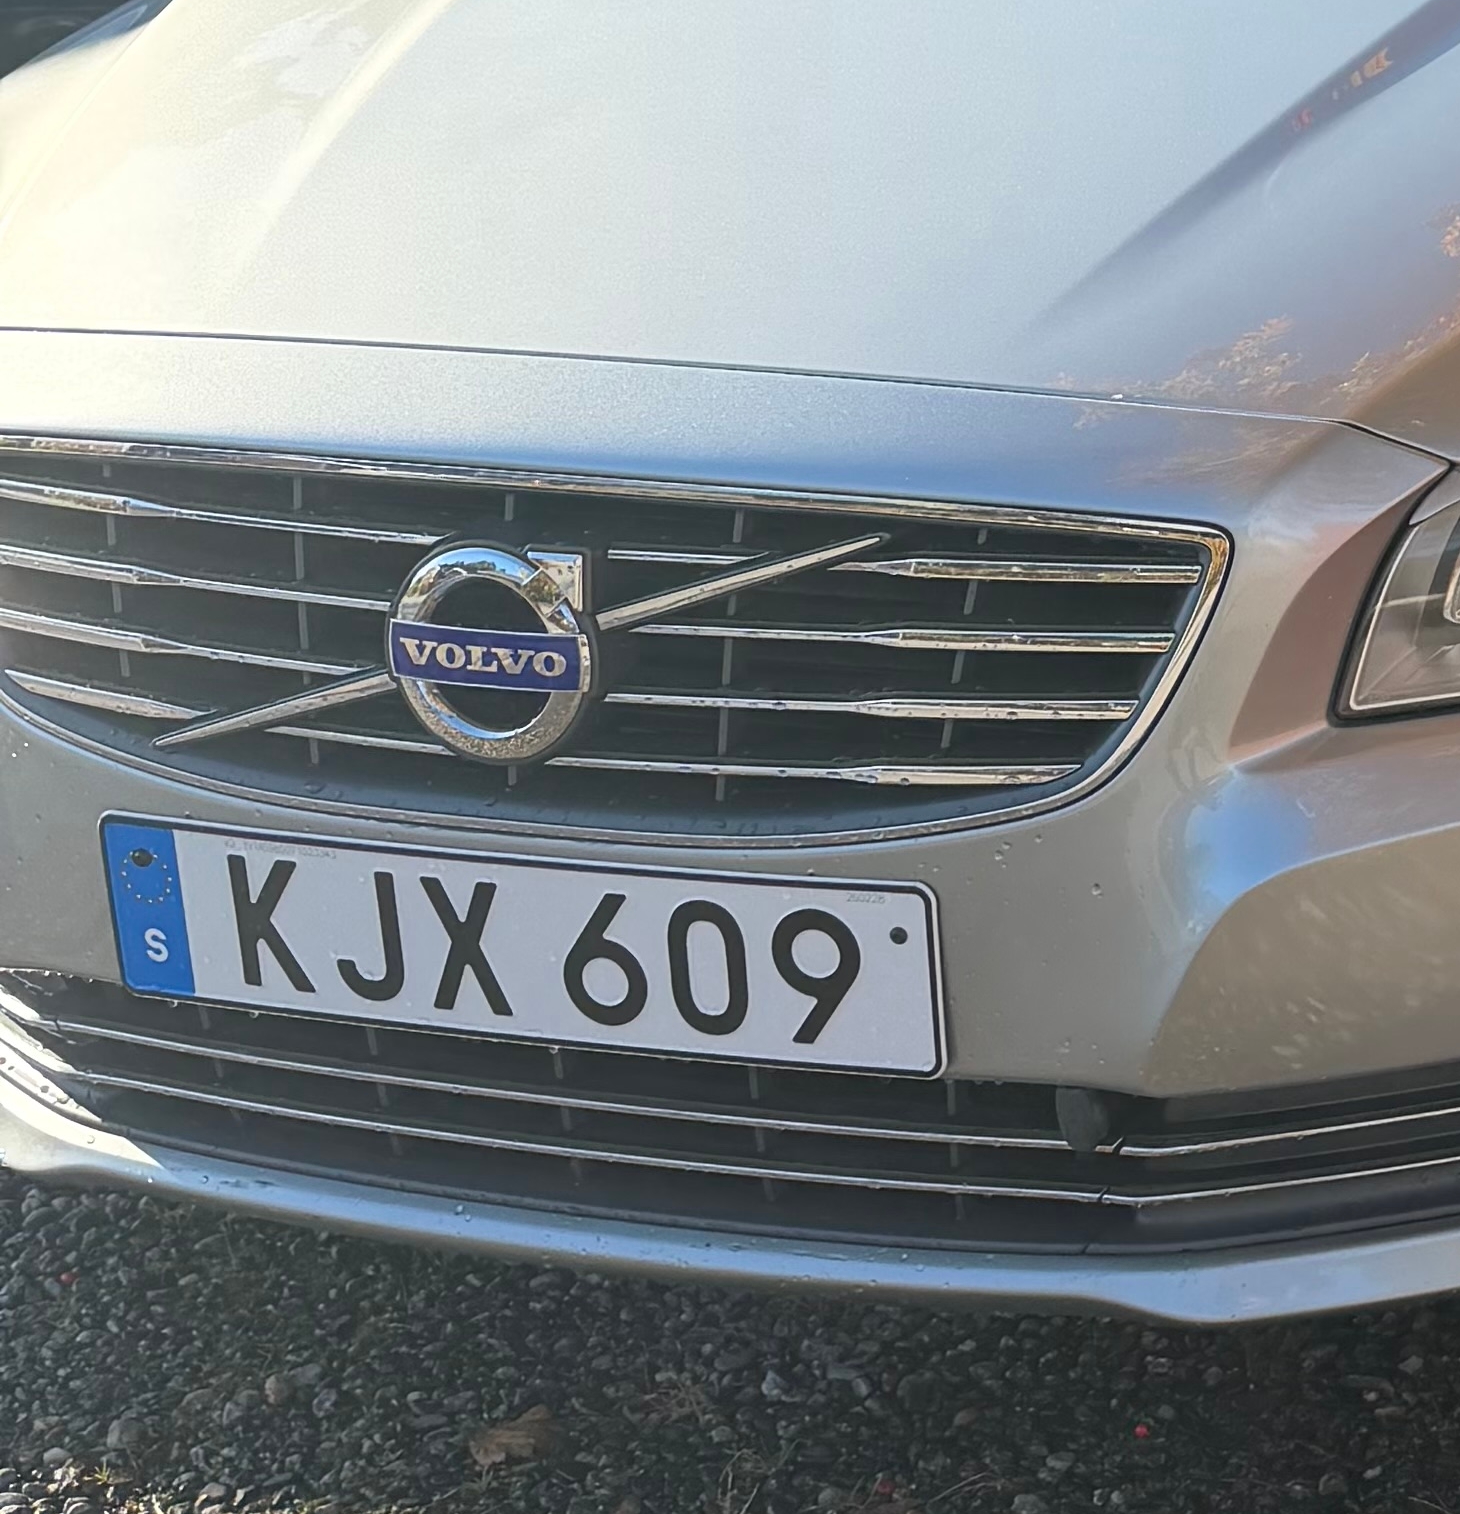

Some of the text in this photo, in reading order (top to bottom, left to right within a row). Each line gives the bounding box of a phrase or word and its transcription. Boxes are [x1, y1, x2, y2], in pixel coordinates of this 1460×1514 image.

[400, 637, 567, 677] VOLVO
[144, 928, 168, 962] S
[226, 854, 861, 1045] KJX 609
